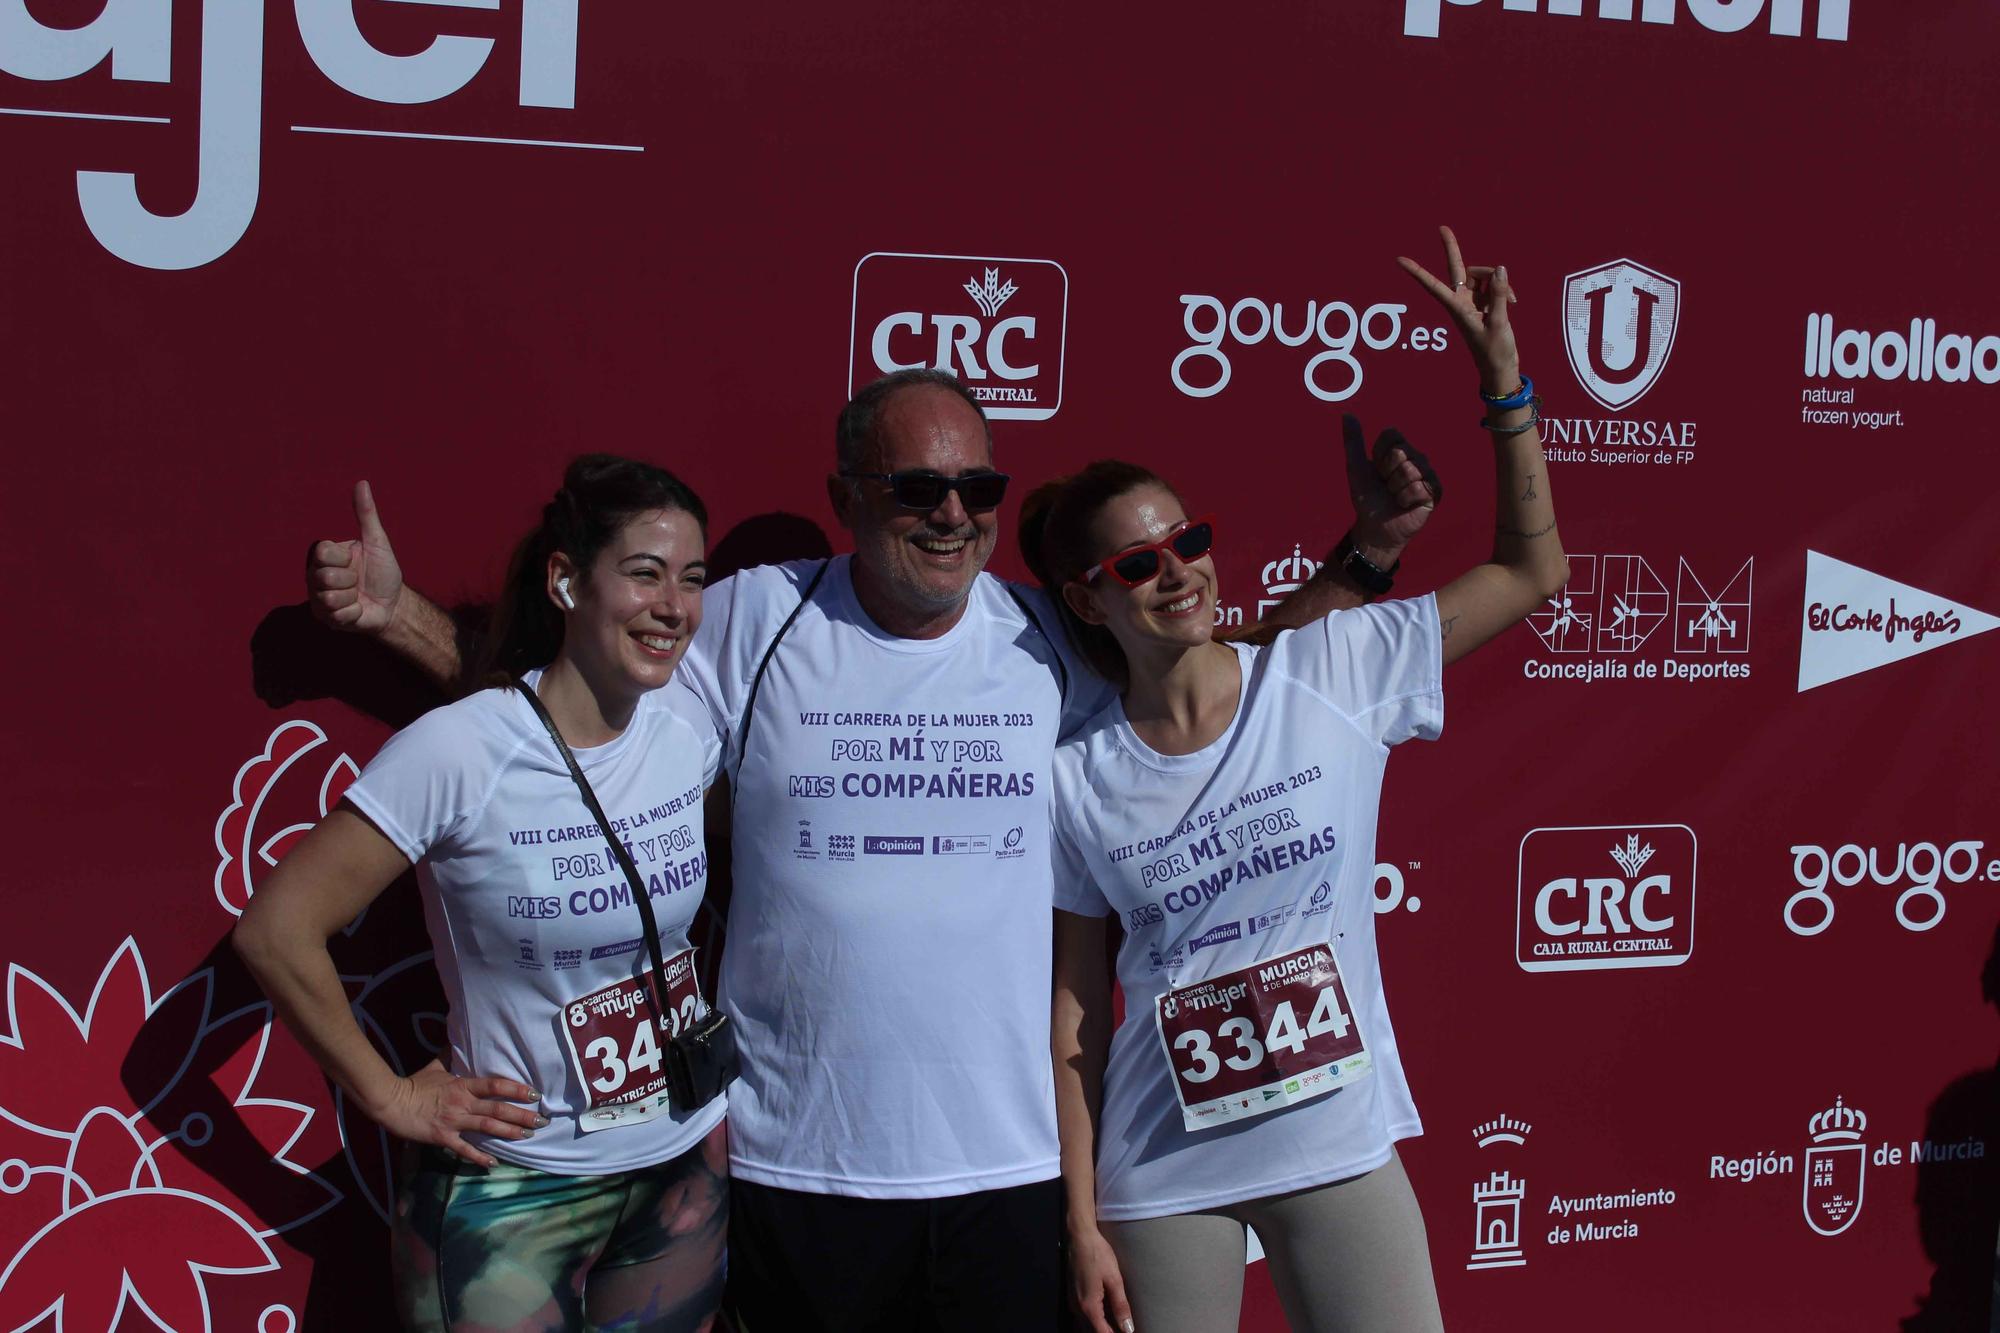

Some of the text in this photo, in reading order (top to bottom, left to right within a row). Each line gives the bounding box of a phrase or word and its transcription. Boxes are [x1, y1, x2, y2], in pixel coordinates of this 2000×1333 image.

[871, 311, 1039, 380] CRC
[1171, 294, 1448, 402] gougo.es
[1802, 387, 1854, 404] natural
[1802, 406, 1904, 430] frozen yogurt.
[1543, 447, 1695, 466] stituto Superior de FP
[1808, 598, 1961, 643] El Corte Inglés
[1523, 659, 1750, 683] Concejalía de Deportes
[799, 712, 1034, 727] VIII CARRERA DE LA MUJER 2023
[831, 729, 1003, 762] POR MÍ Y POR
[789, 766, 1035, 798] MIS COMPAÑERAS
[509, 830, 542, 845] VIII
[547, 823, 604, 844] CARRER
[630, 815, 649, 828] LA
[649, 797, 685, 822] MUJER
[1108, 845, 1135, 864] VIII
[1199, 810, 1218, 828] DE
[1219, 802, 1237, 819] LA
[1239, 781, 1288, 809] MUJER
[1288, 765, 1322, 790] 2023
[553, 853, 605, 881] POR
[639, 838, 656, 862] Y
[658, 824, 696, 857] POR
[828, 849, 855, 858] Murcia
[1141, 807, 1301, 888] POR MÍ Y POR
[1128, 826, 1336, 932] MIS COMPAÑERAS
[508, 896, 562, 918] MIS
[1534, 874, 1674, 936] CRC
[1533, 938, 1673, 956] CAJA RURAL CENTRAL
[664, 956, 691, 981] URCIA
[1259, 950, 1326, 983] MURCIA
[1264, 984, 1269, 992] 5
[1271, 981, 1281, 990] DE
[1282, 971, 1310, 986] MARZO
[587, 987, 622, 1006] carrera
[1180, 983, 1216, 1000] carrera
[1193, 981, 1247, 1013] mujer
[1174, 985, 1351, 1084] 3344
[1709, 1136, 1985, 1183] Región de Murcia
[1548, 1188, 1676, 1217] Ayuntamiento
[1547, 1219, 1638, 1245] de Murcia
